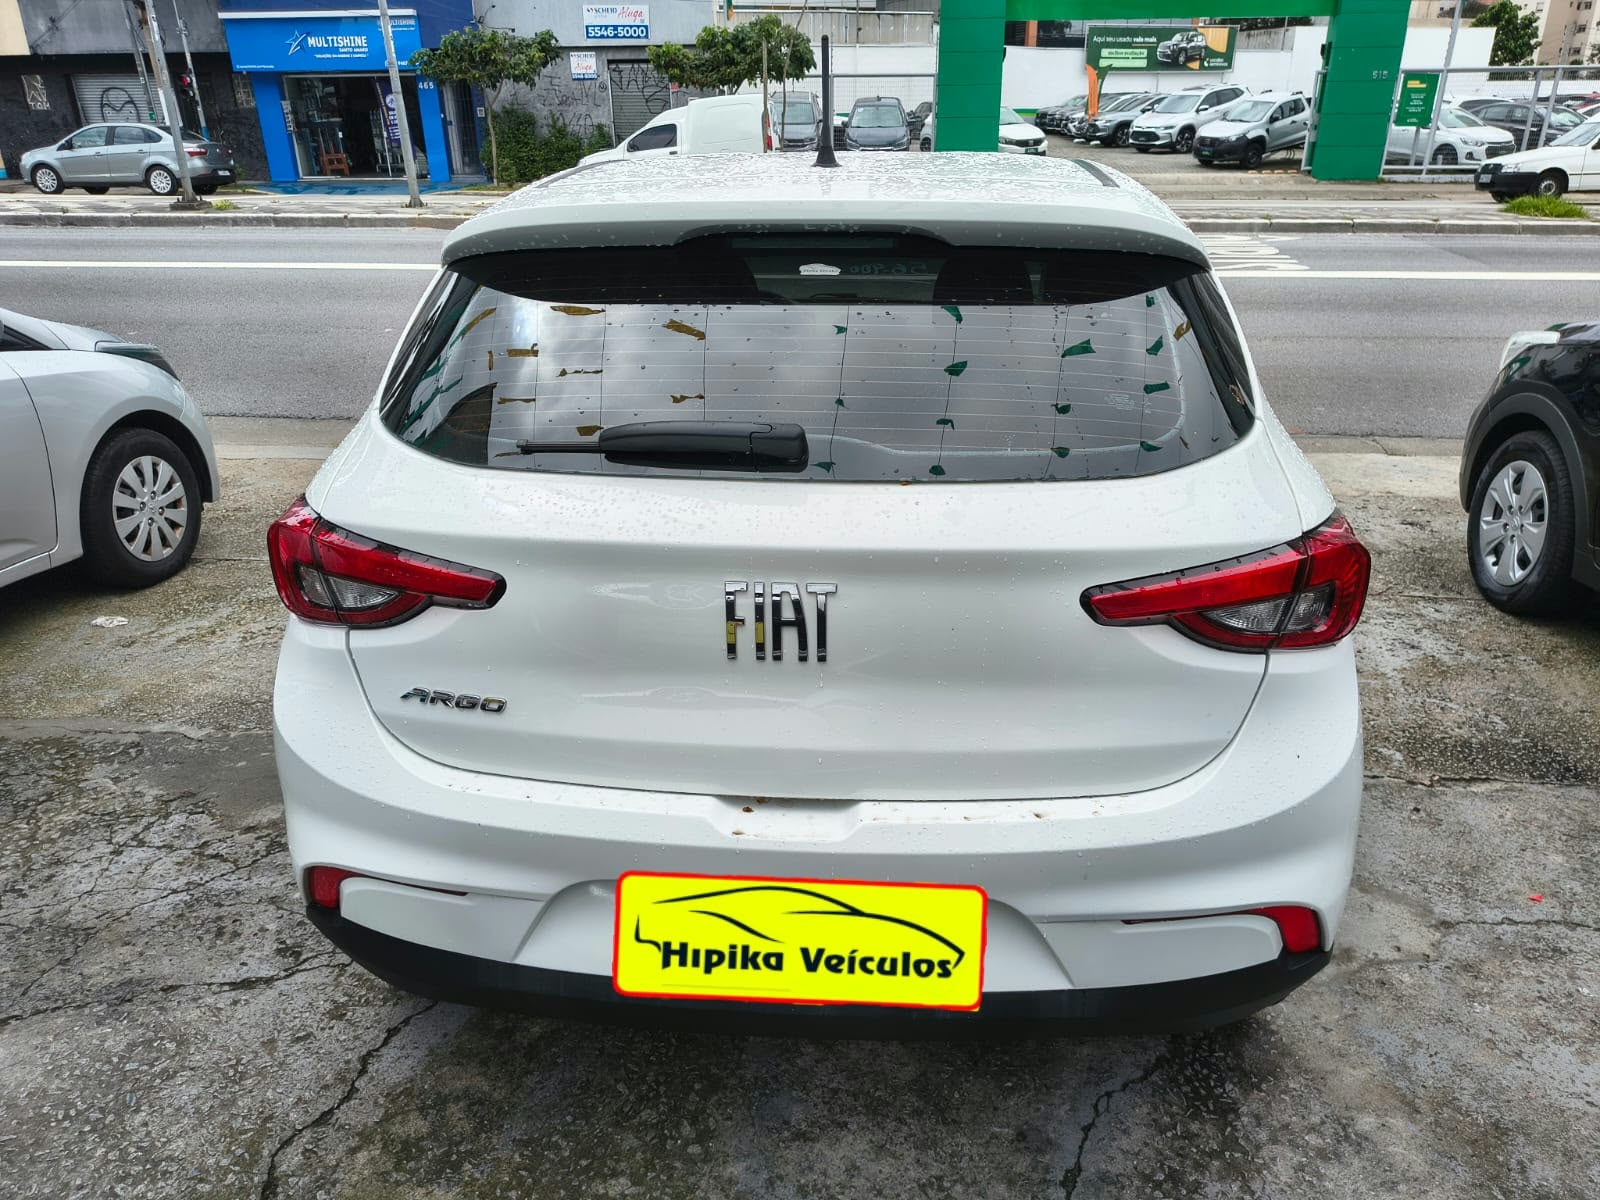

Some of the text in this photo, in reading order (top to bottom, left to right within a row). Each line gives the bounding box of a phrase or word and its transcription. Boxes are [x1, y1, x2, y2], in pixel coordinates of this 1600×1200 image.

[618, 6, 643, 22] Aluga
[588, 26, 646, 37] 5546-5000
[307, 36, 367, 48] MULTISHINE
[1093, 35, 1105, 43] Aqui
[725, 581, 837, 662] FIAT
[400, 687, 507, 712] ARGO
